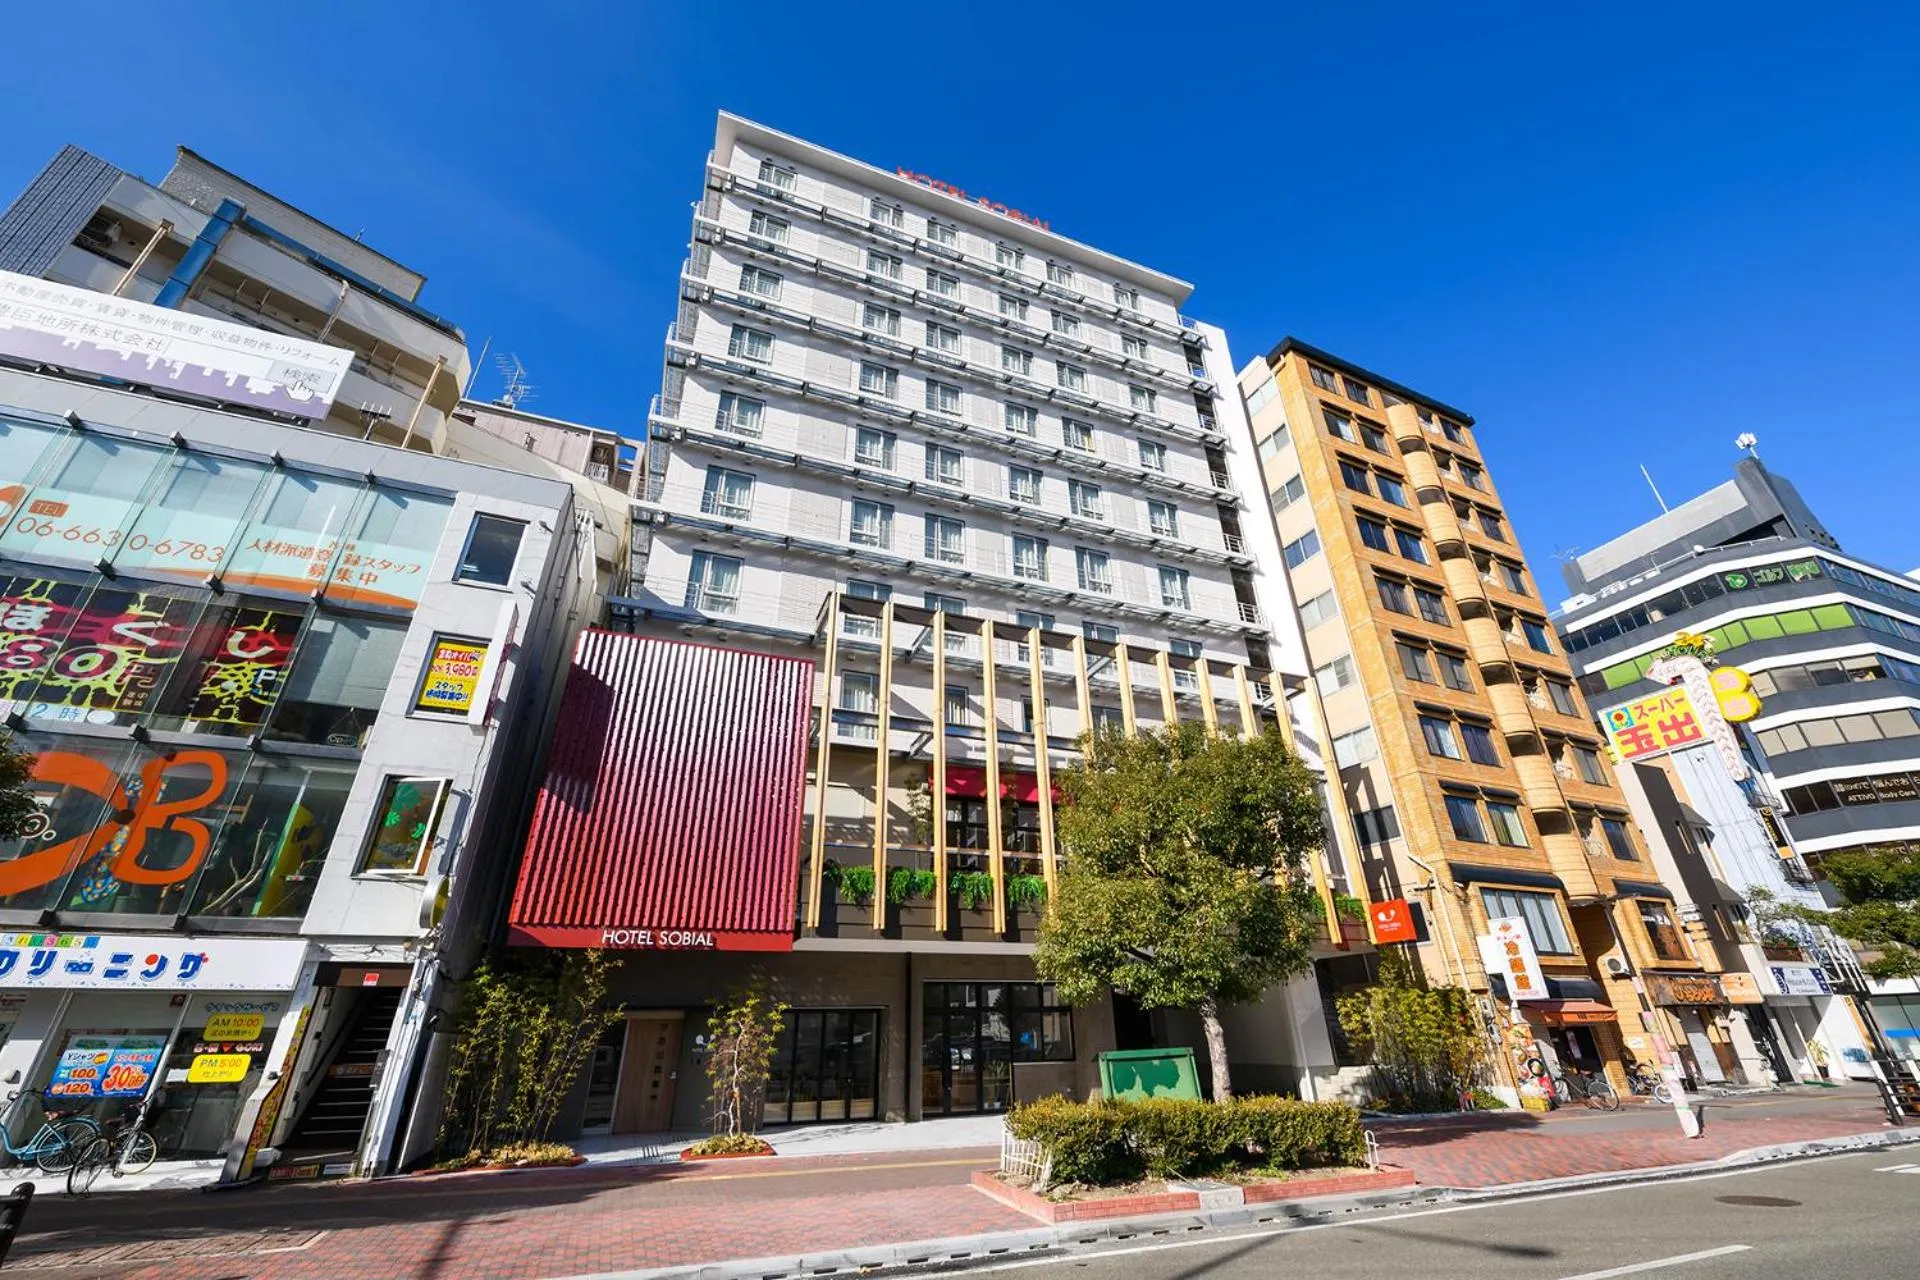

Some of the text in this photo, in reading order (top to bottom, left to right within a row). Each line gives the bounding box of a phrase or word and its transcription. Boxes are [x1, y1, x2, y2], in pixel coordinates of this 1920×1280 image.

[16, 516, 225, 564] 06-6630-6783
[1633, 694, 1685, 721] スーパー
[1616, 711, 1703, 759] 玉出
[602, 929, 714, 946] HOTEL SOBIAL
[212, 1018, 260, 1028] AM 10:00
[200, 1058, 243, 1067] PM 5:00
[104, 1064, 132, 1090] 30
